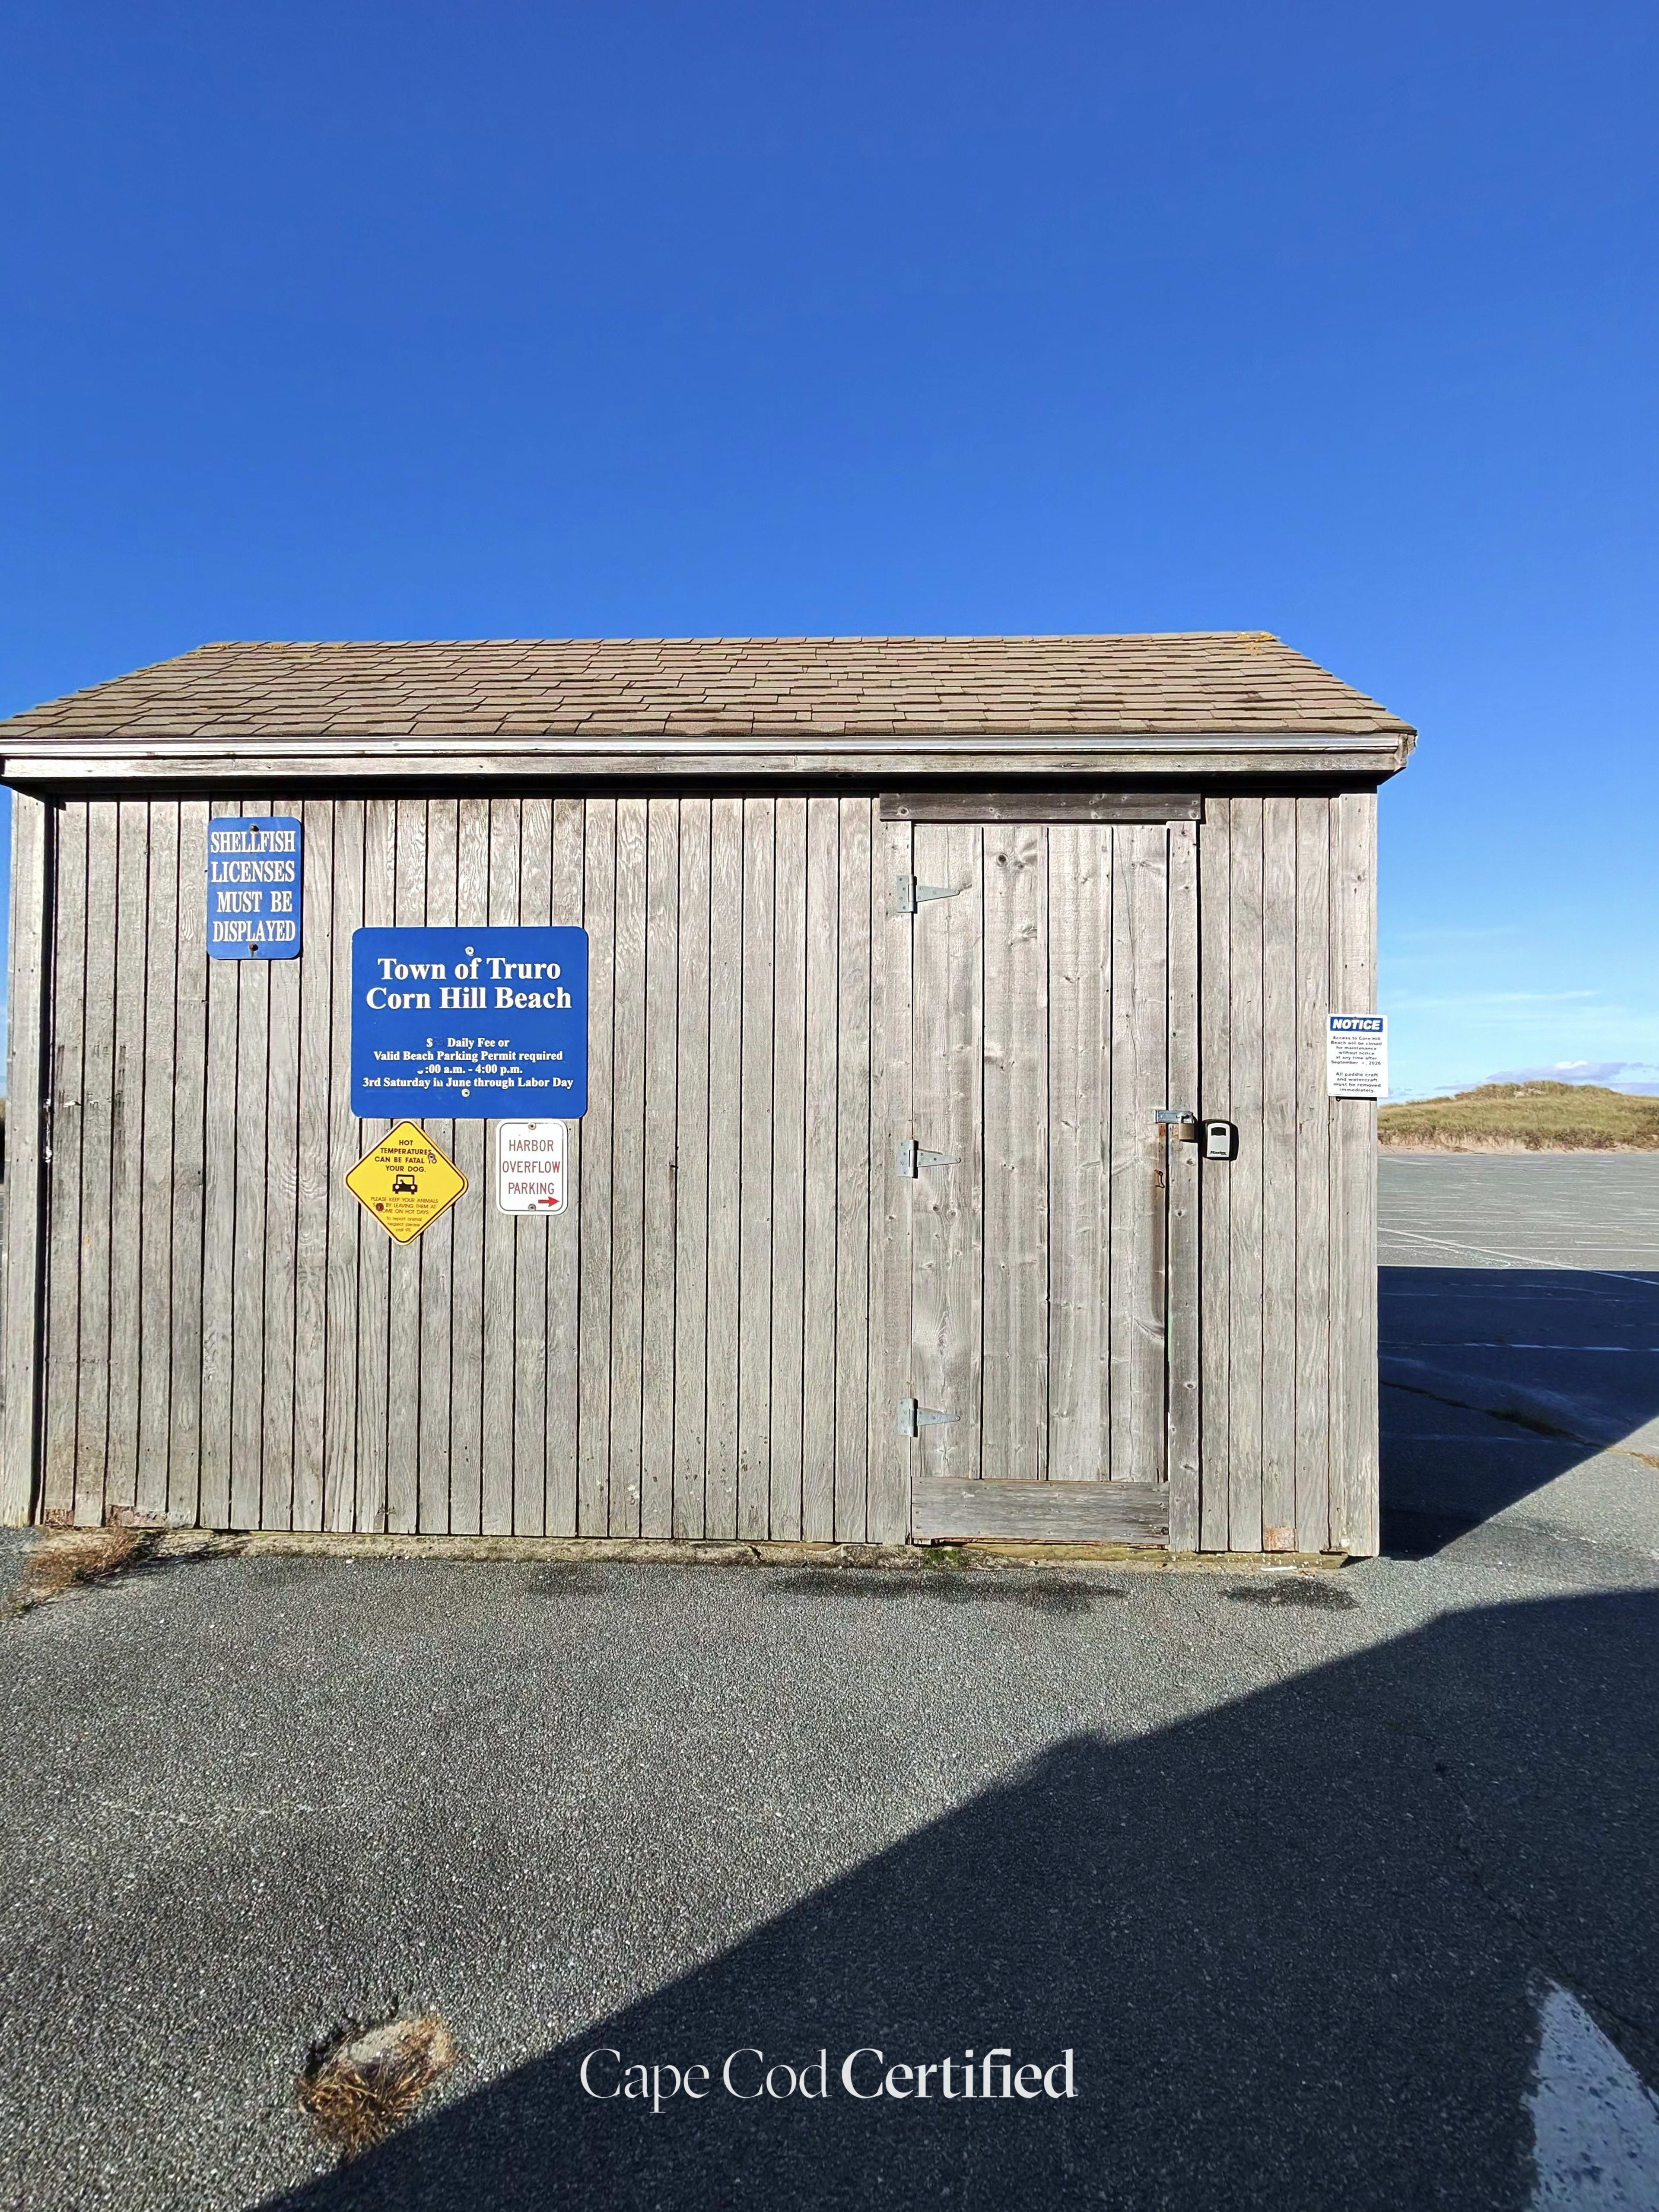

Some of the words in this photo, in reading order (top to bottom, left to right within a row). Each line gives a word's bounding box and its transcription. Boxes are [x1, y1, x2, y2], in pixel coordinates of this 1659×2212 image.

[211, 831, 296, 853] SHELLFISH
[211, 861, 295, 883] LICENSES
[217, 891, 262, 912] MUST
[270, 891, 292, 912] BE
[213, 920, 296, 942] DISPLAYED
[378, 958, 446, 980] Town
[454, 957, 482, 979] of
[486, 957, 561, 979] Truro
[366, 987, 431, 1009] Corn
[439, 987, 486, 1009] Hill
[494, 986, 572, 1009] Beach
[1332, 1019, 1381, 1030] NOTICE
[447, 1037, 474, 1049] Daily
[477, 1038, 496, 1047] Fee
[373, 1051, 400, 1060] Valid
[403, 1051, 434, 1060] Beach
[436, 1051, 478, 1063] Parking
[481, 1051, 516, 1060] Permit
[519, 1051, 563, 1063] required
[417, 1064, 441, 1074] :00
[475, 1064, 497, 1074] 4:00
[500, 1066, 523, 1076] p.m.
[362, 1077, 381, 1087] 3rd
[383, 1077, 431, 1089] Saturday
[433, 1077, 443, 1087] in
[445, 1077, 471, 1087] June
[474, 1077, 515, 1089] through
[518, 1077, 550, 1087] Labor
[552, 1077, 574, 1089] Day
[509, 1140, 553, 1151] HARBOR
[502, 1161, 560, 1173] OVERFLOW
[509, 1182, 554, 1195] PARKING
